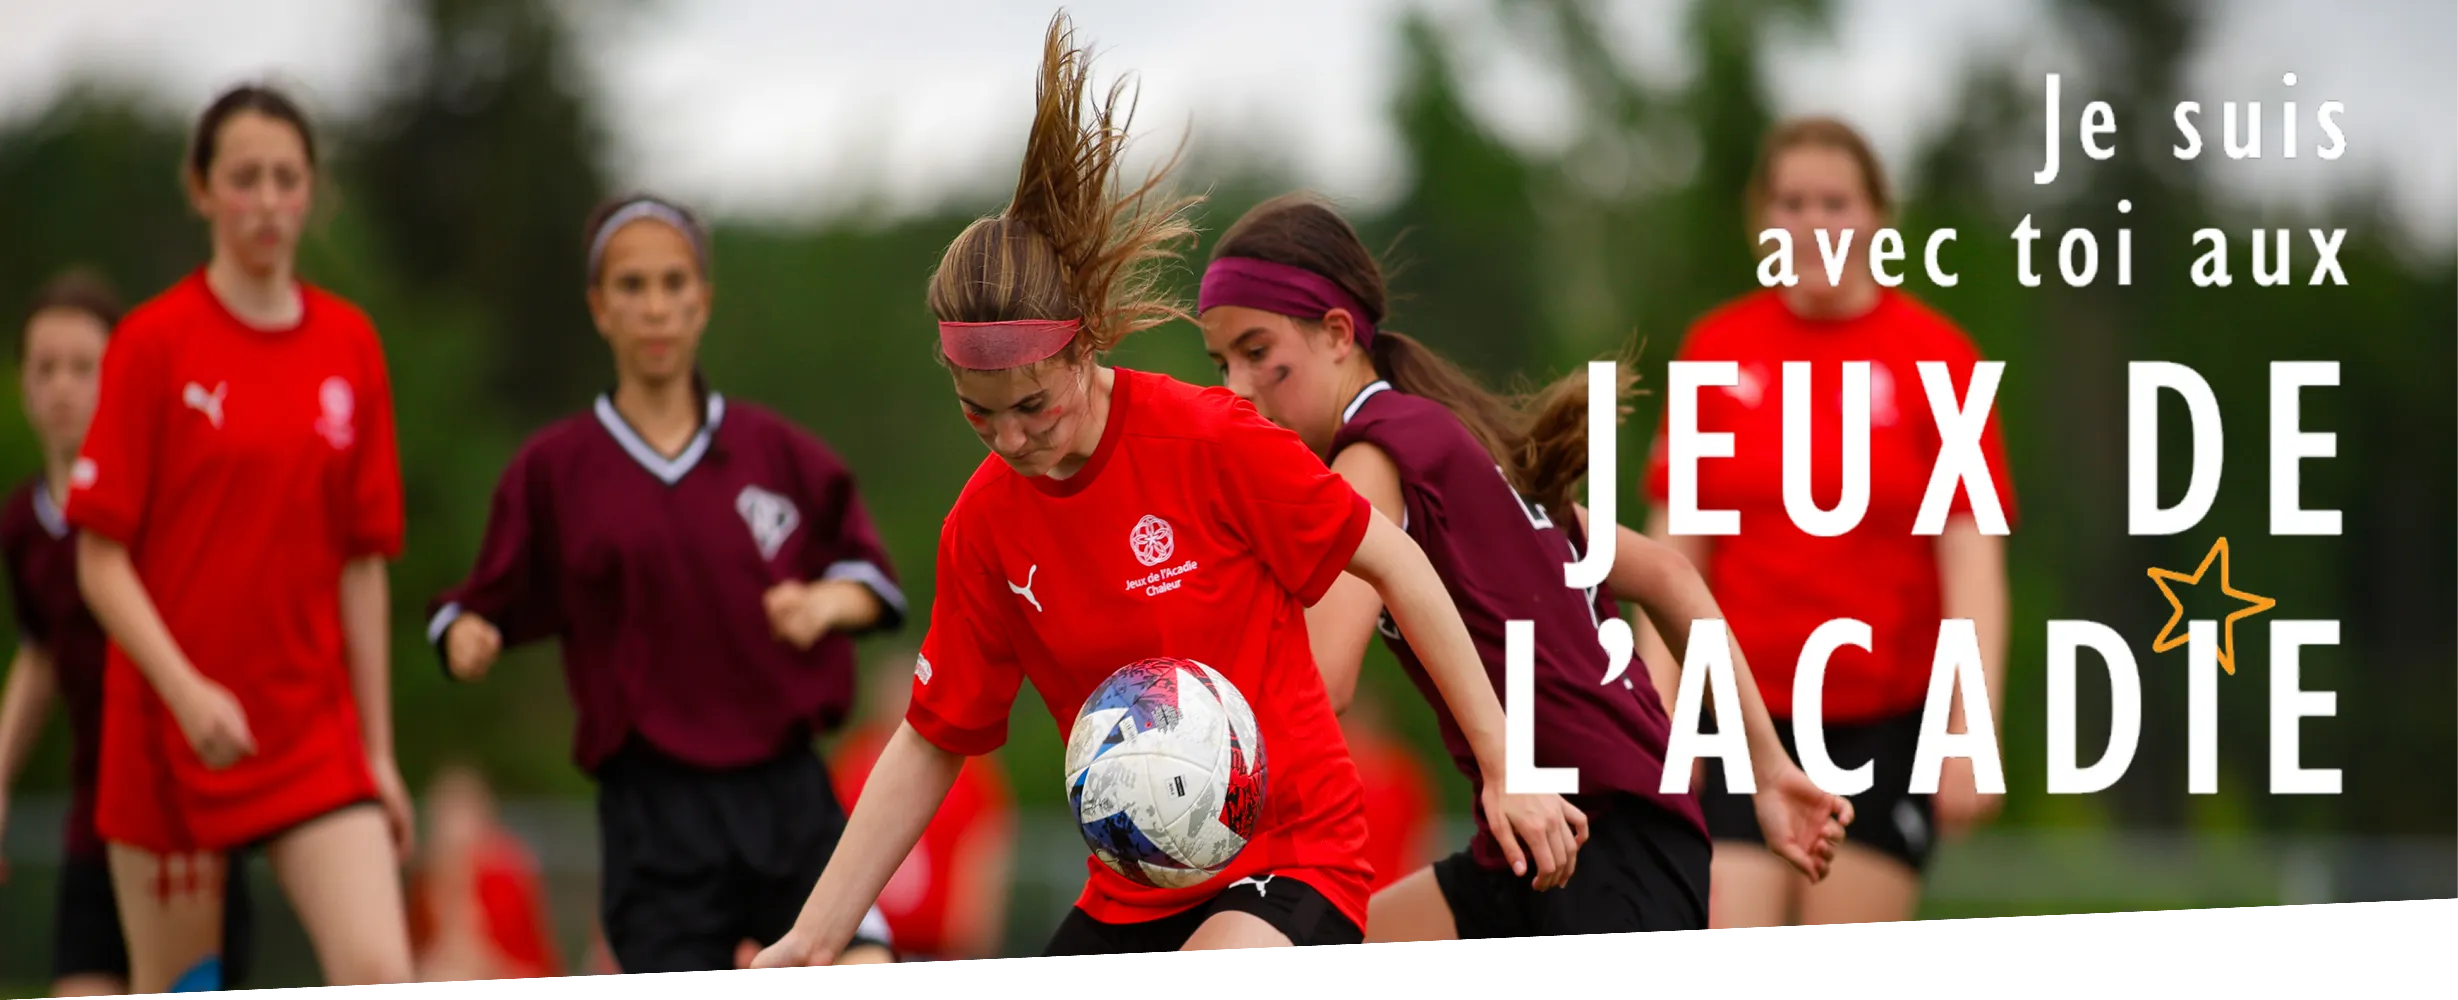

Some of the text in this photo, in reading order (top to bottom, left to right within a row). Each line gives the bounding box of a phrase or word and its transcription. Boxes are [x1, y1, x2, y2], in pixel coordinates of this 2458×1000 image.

[1125, 577, 1147, 591] Jeux
[1147, 572, 1160, 584] de
[1145, 579, 1182, 597] Chaleur
